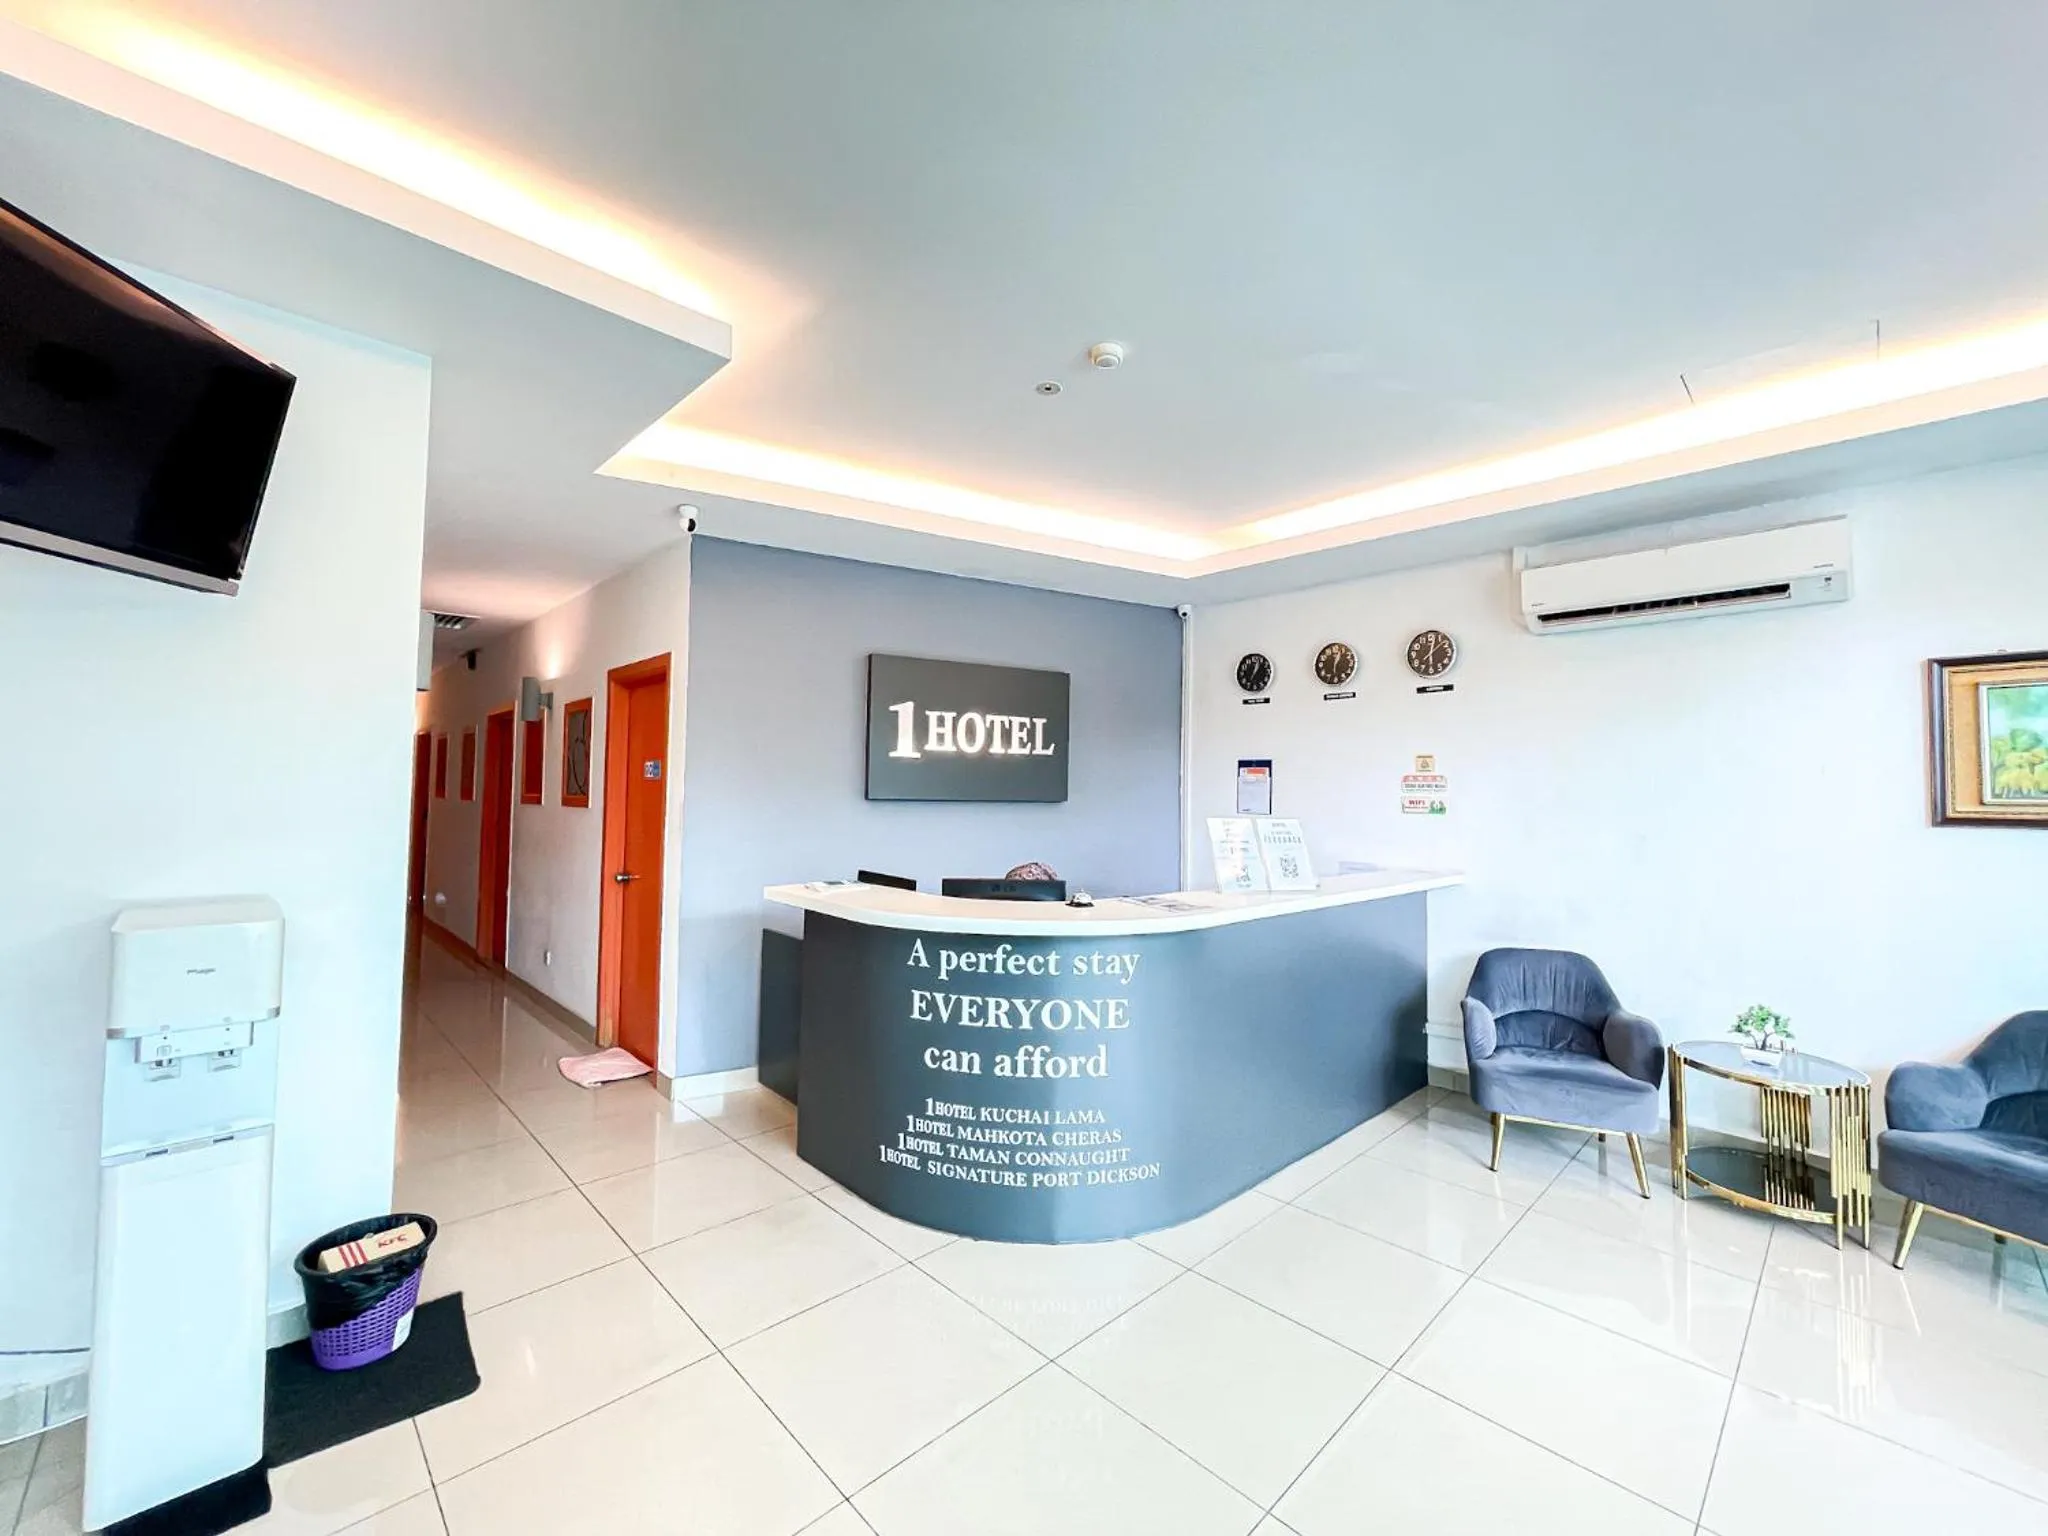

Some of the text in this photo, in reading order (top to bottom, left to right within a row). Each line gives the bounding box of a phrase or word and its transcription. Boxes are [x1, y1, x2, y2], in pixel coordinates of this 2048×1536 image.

[907, 938, 1141, 984] A perfect stay
[910, 989, 1130, 1030] EVERYONE
[924, 1044, 1109, 1078] can afford
[980, 1107, 1049, 1125] KUCHAI
[1055, 1110, 1106, 1125] LAMA
[957, 1126, 1047, 1146] MAHKOTA
[1052, 1128, 1122, 1146] CHERAS
[946, 1143, 1010, 1165] TAMAN
[1015, 1148, 1131, 1166] CONNAUGHT
[927, 1160, 1027, 1187] SIGNATURE
[1032, 1171, 1082, 1188] PORT
[1087, 1162, 1161, 1186] DICKSON
